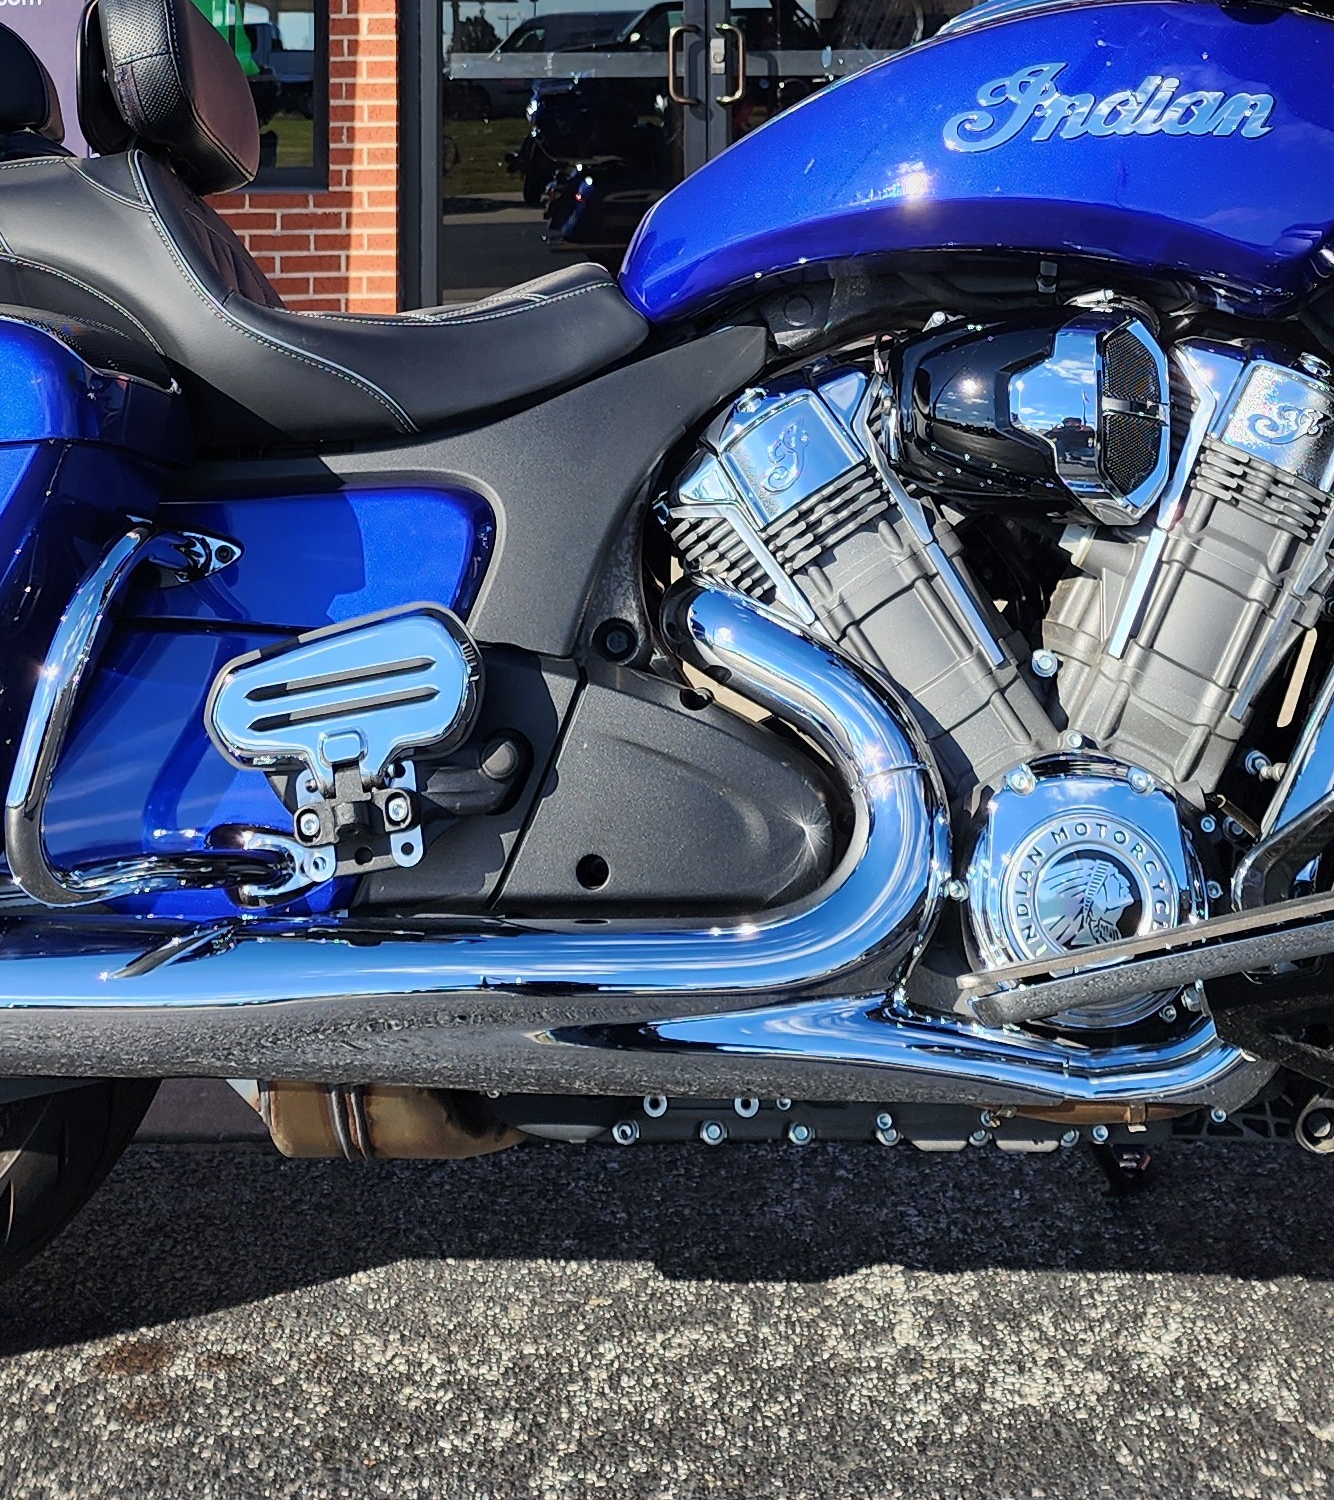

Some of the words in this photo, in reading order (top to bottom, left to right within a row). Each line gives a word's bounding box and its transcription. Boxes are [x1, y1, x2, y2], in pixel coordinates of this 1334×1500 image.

[942, 62, 1275, 153] Indian
[1016, 847, 1048, 957] INDIAN
[1049, 821, 1170, 930] MOTORCYCL
